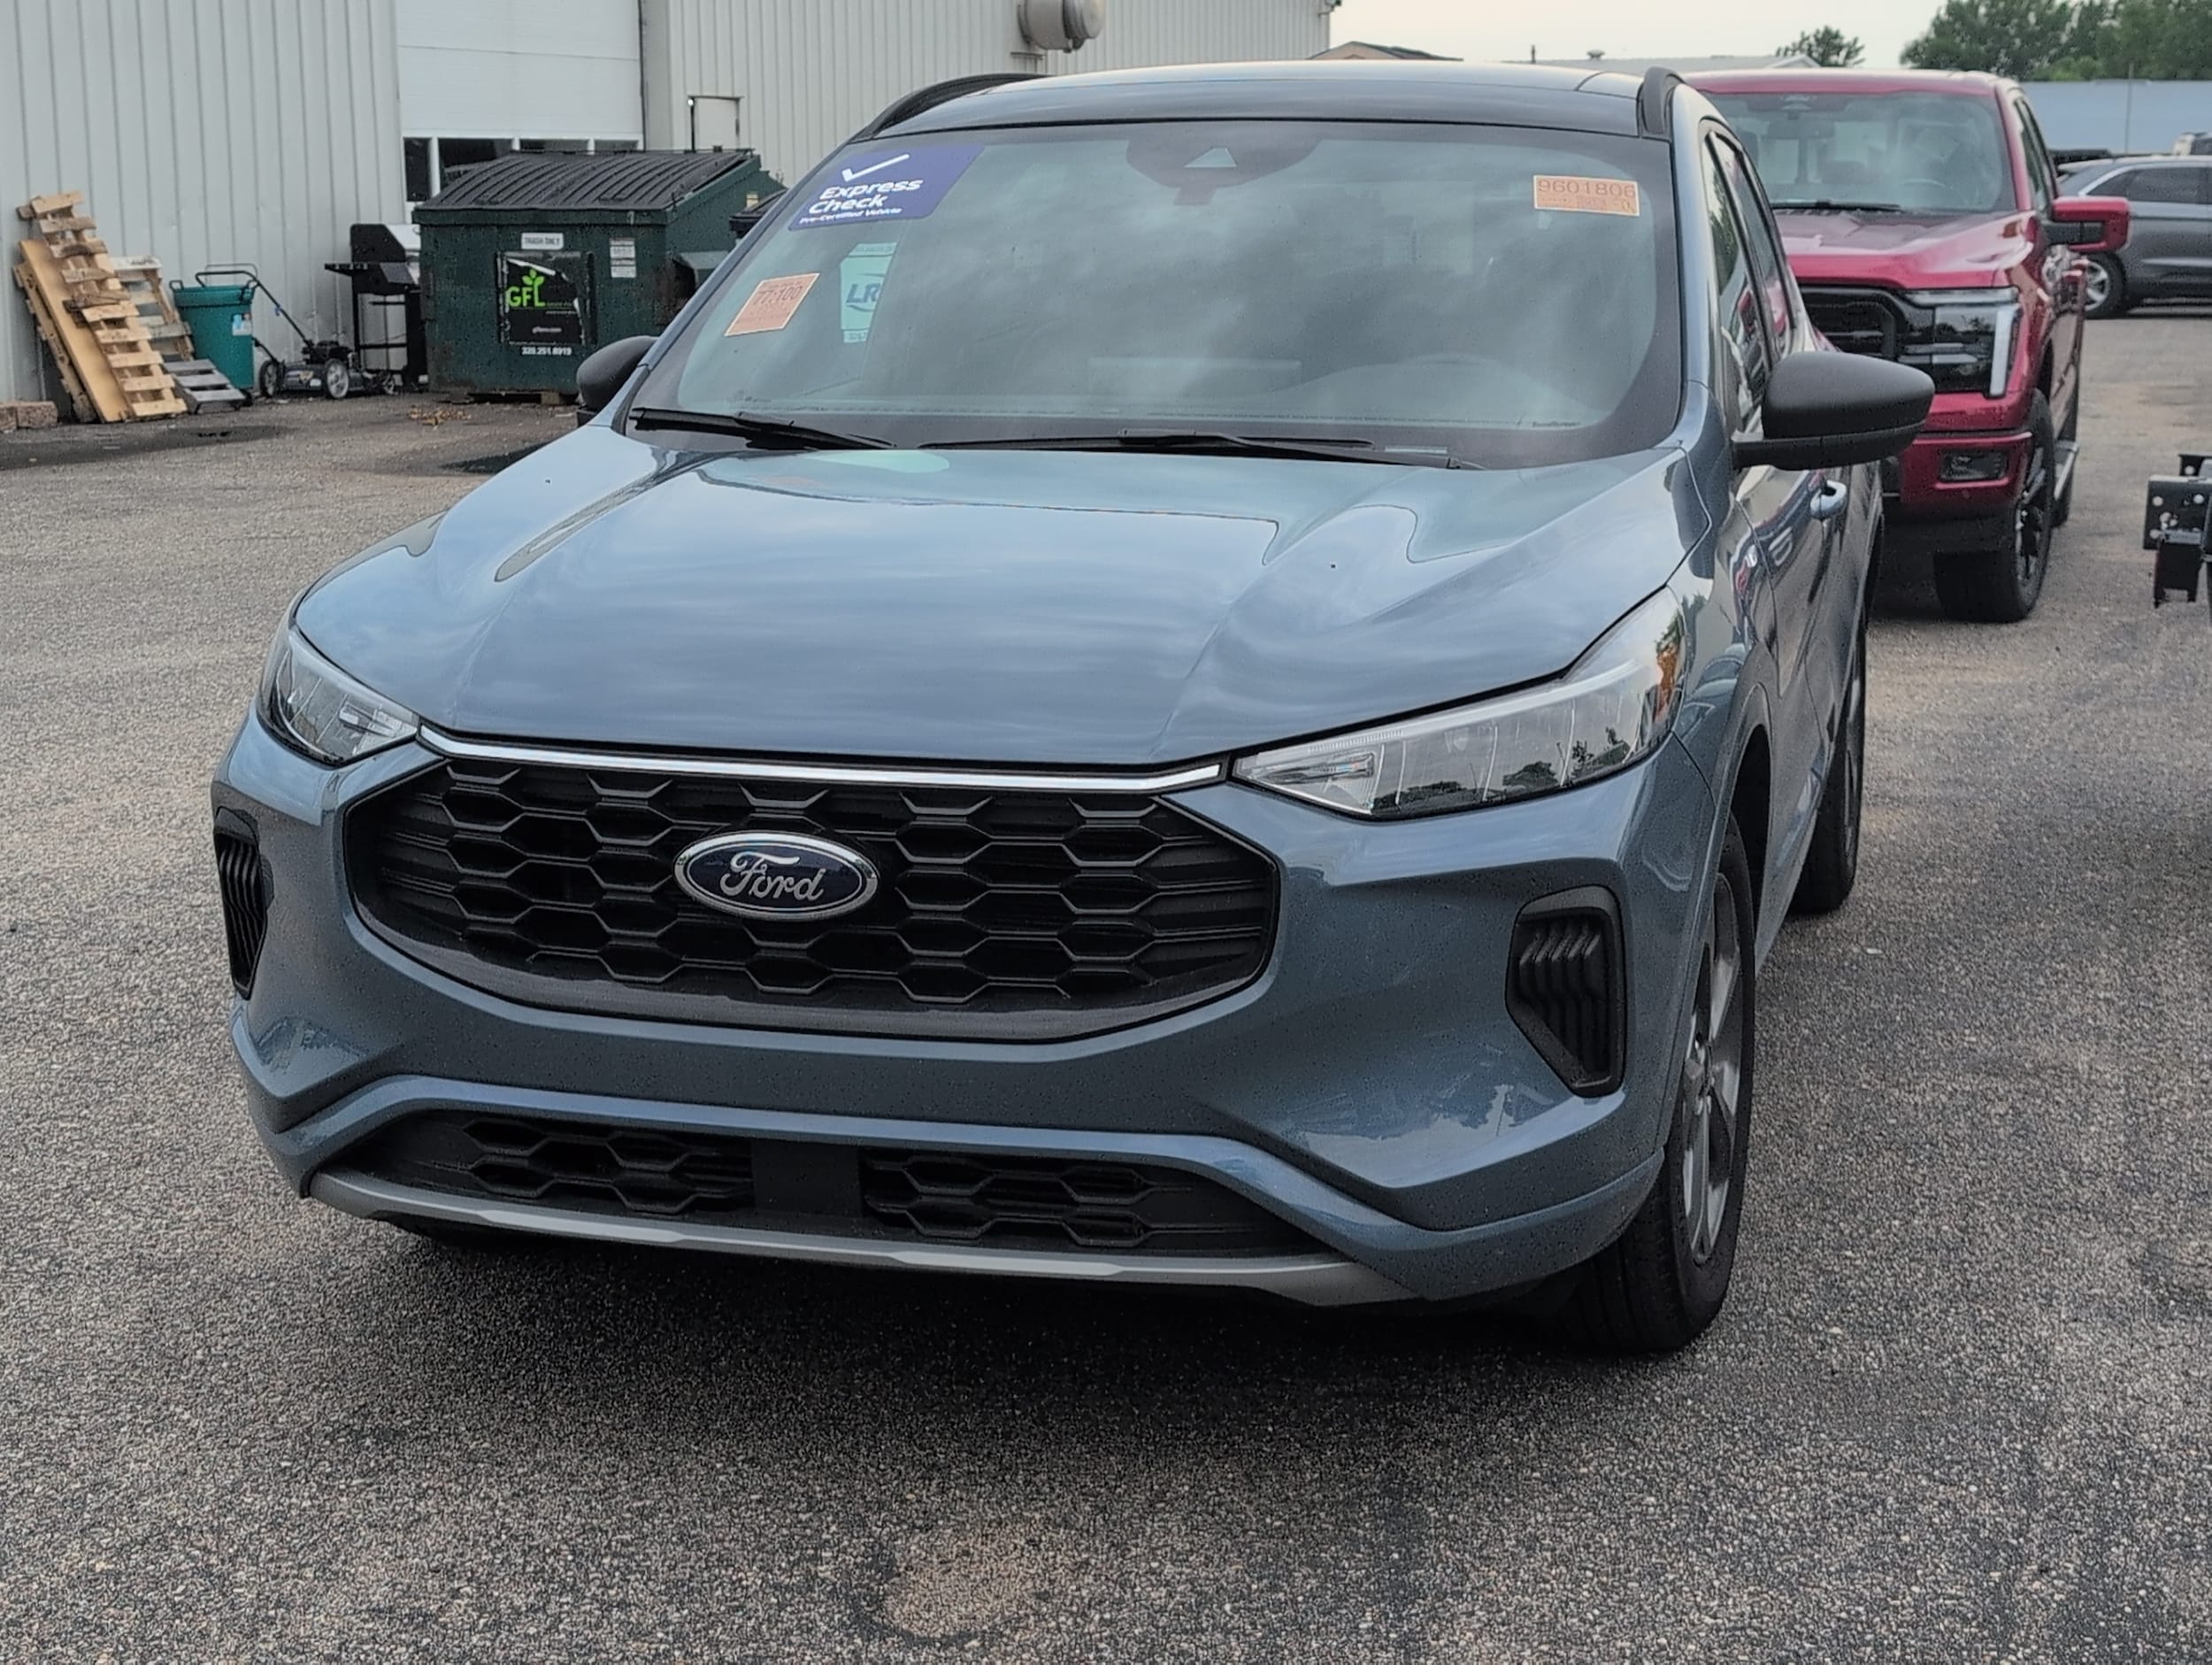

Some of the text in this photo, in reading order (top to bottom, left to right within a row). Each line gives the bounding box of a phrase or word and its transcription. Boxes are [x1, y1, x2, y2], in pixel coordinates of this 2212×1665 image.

[818, 179, 924, 200] Express
[1538, 179, 1636, 198] 9601806
[809, 194, 888, 214] Check
[505, 281, 545, 307] GFL
[719, 850, 827, 902] Ford
